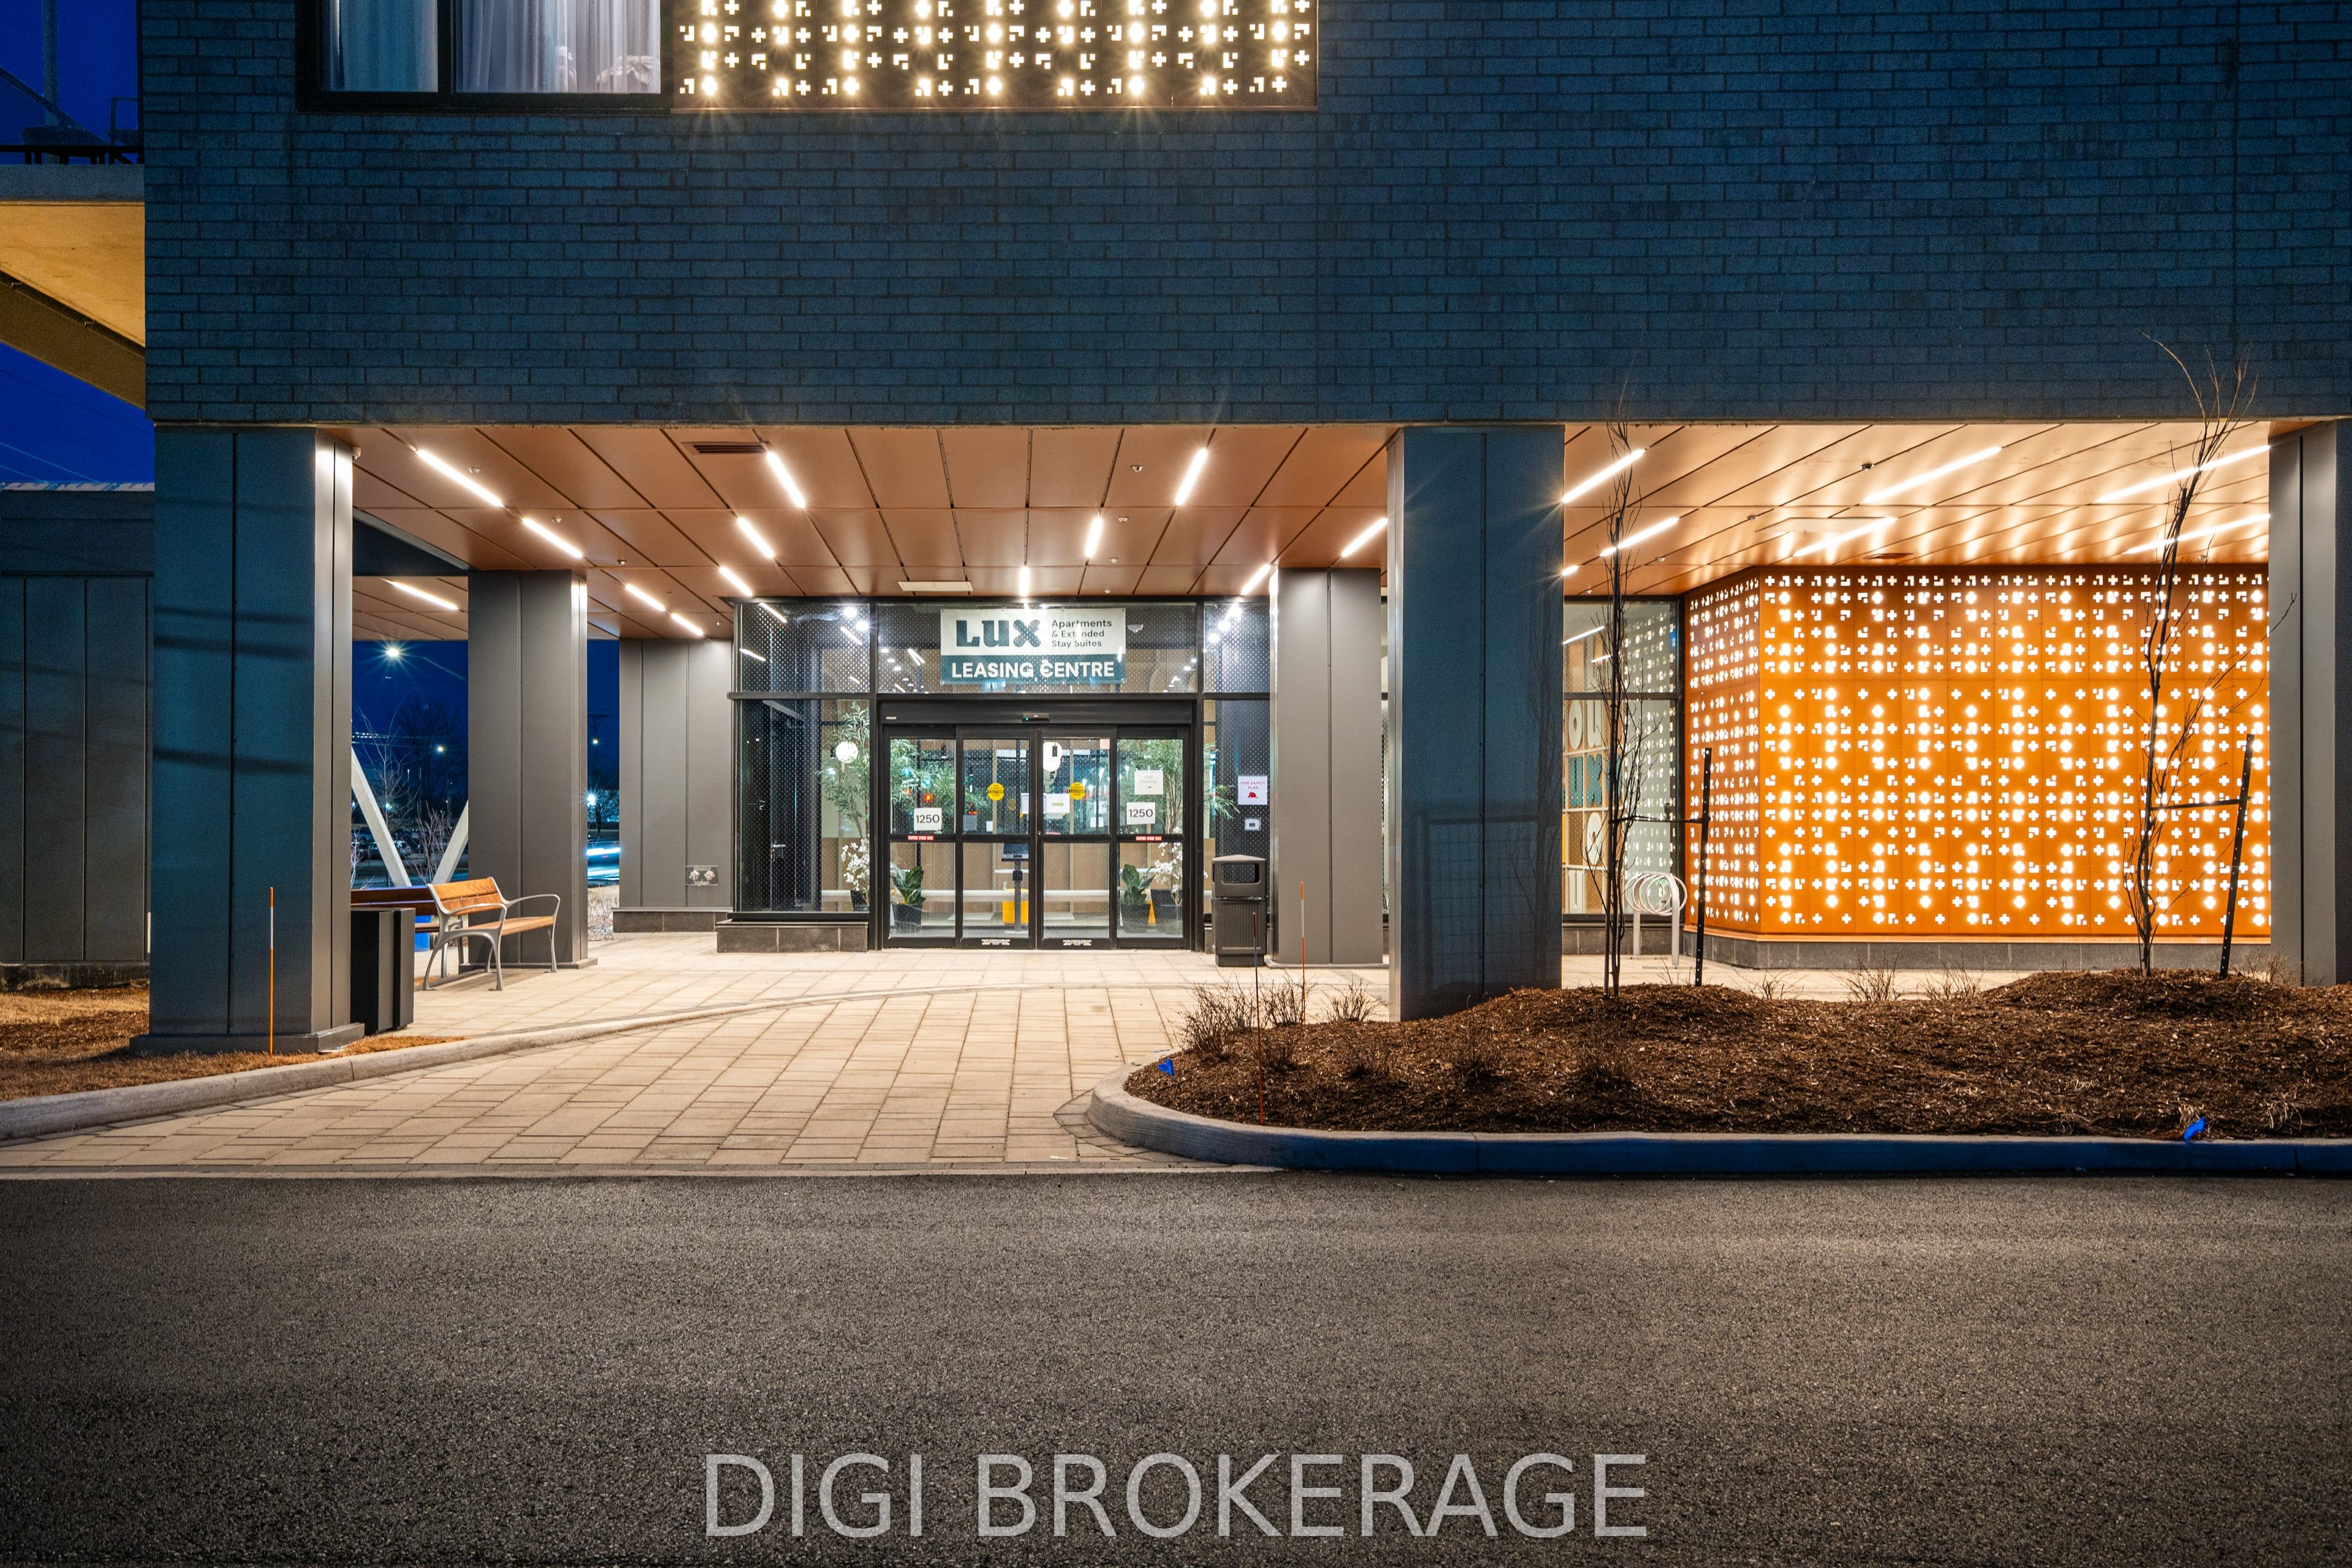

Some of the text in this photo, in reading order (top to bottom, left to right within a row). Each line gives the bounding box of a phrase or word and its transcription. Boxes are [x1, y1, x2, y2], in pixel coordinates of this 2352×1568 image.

[1052, 620, 1112, 630] Apartments
[1052, 640, 1071, 649] Stay
[952, 662, 1114, 678] LEASING CENTRE
[1129, 809, 1153, 818] 1250
[916, 814, 940, 823] 1250
